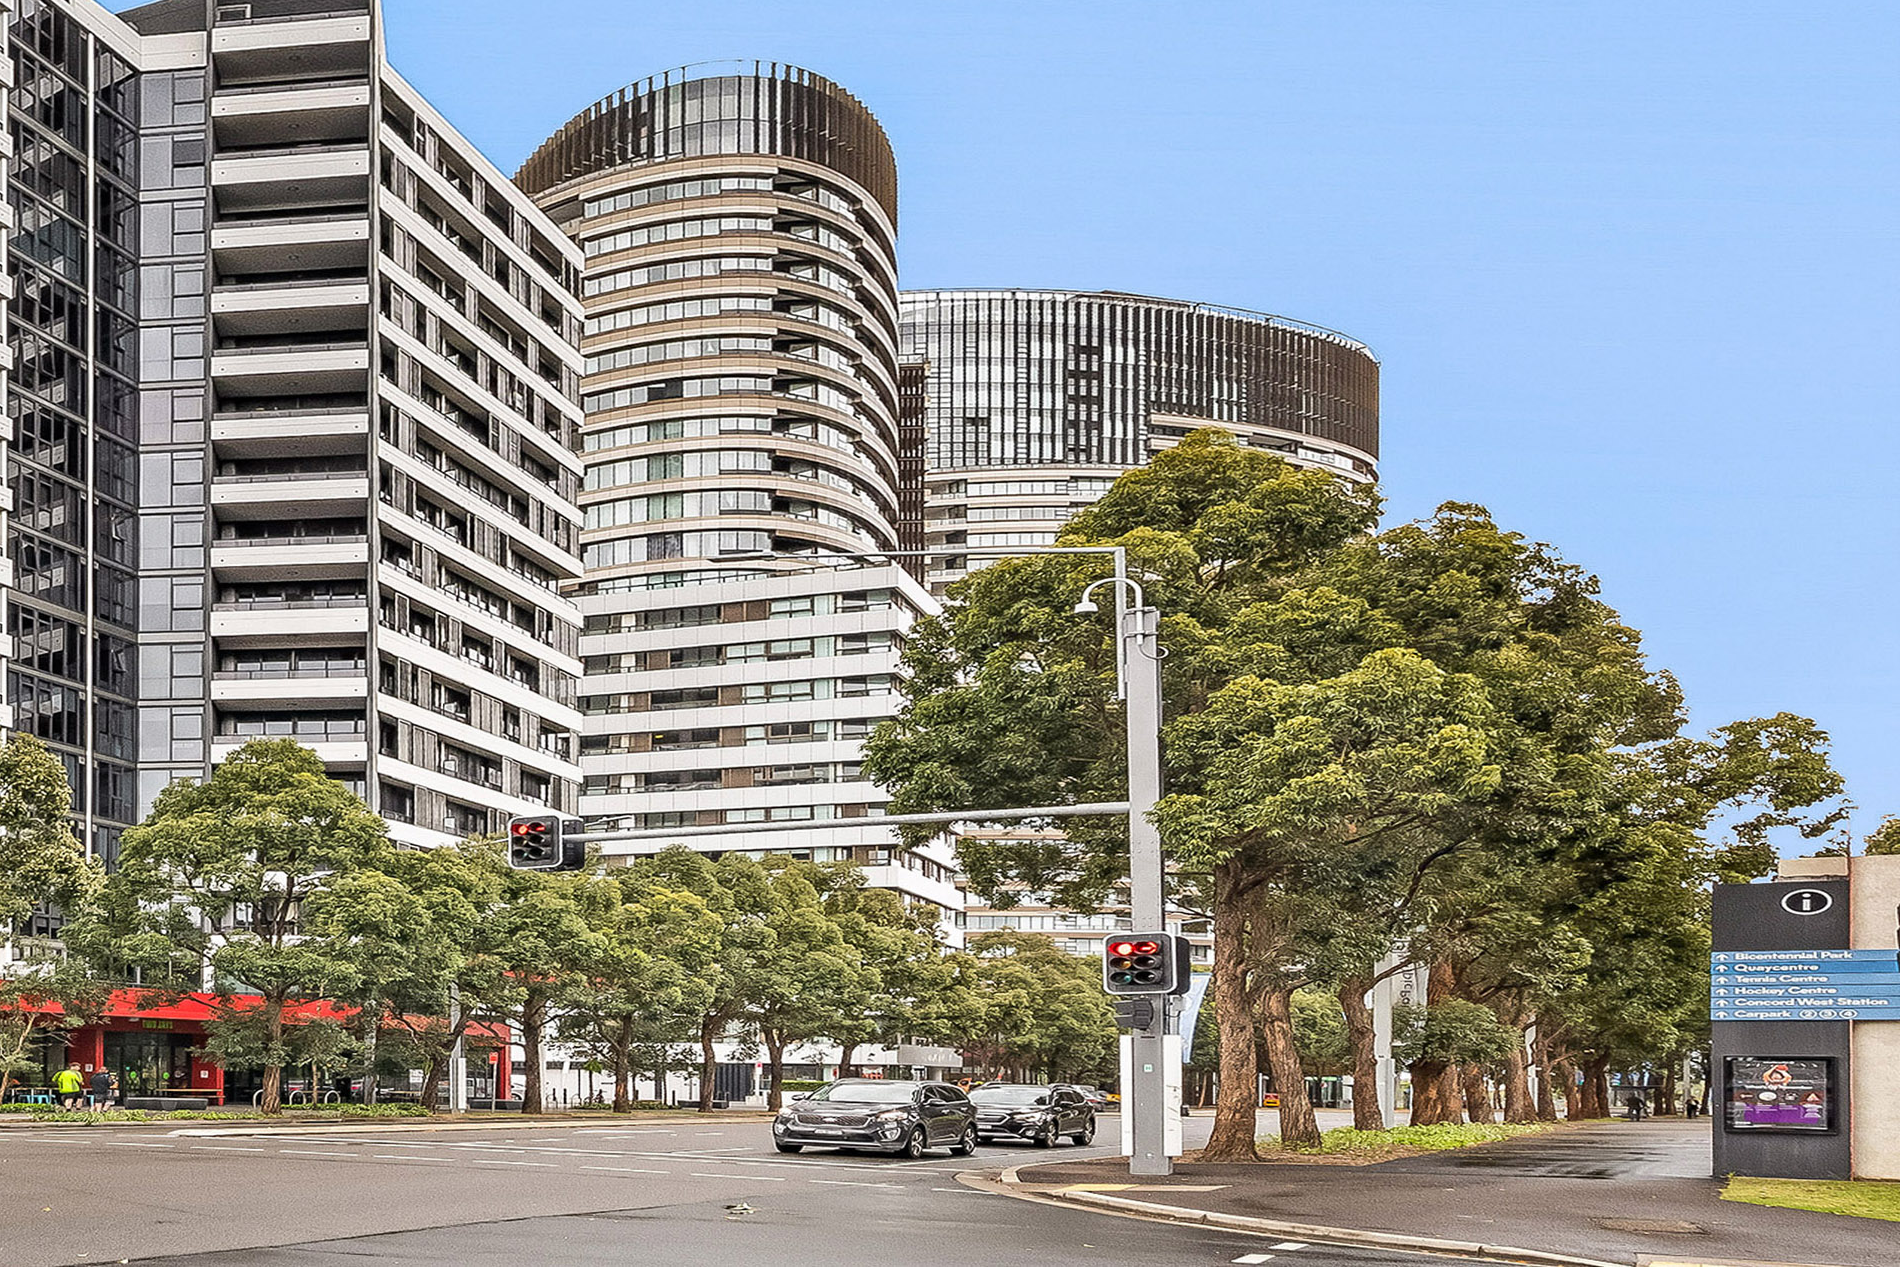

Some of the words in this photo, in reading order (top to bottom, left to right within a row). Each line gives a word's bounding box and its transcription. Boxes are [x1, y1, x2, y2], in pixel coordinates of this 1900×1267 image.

[1734, 951, 1817, 960] Bicentennial
[1821, 951, 1852, 959] Park
[1734, 964, 1819, 973] Quaycentre
[1735, 975, 1777, 983] Tennis
[1779, 975, 1828, 983] Centre
[1734, 987, 1786, 996] Hockey
[1734, 998, 1795, 1006] Concord
[1798, 998, 1833, 1006] West
[1836, 997, 1888, 1005] Station
[1734, 1010, 1791, 1019] Carpark
